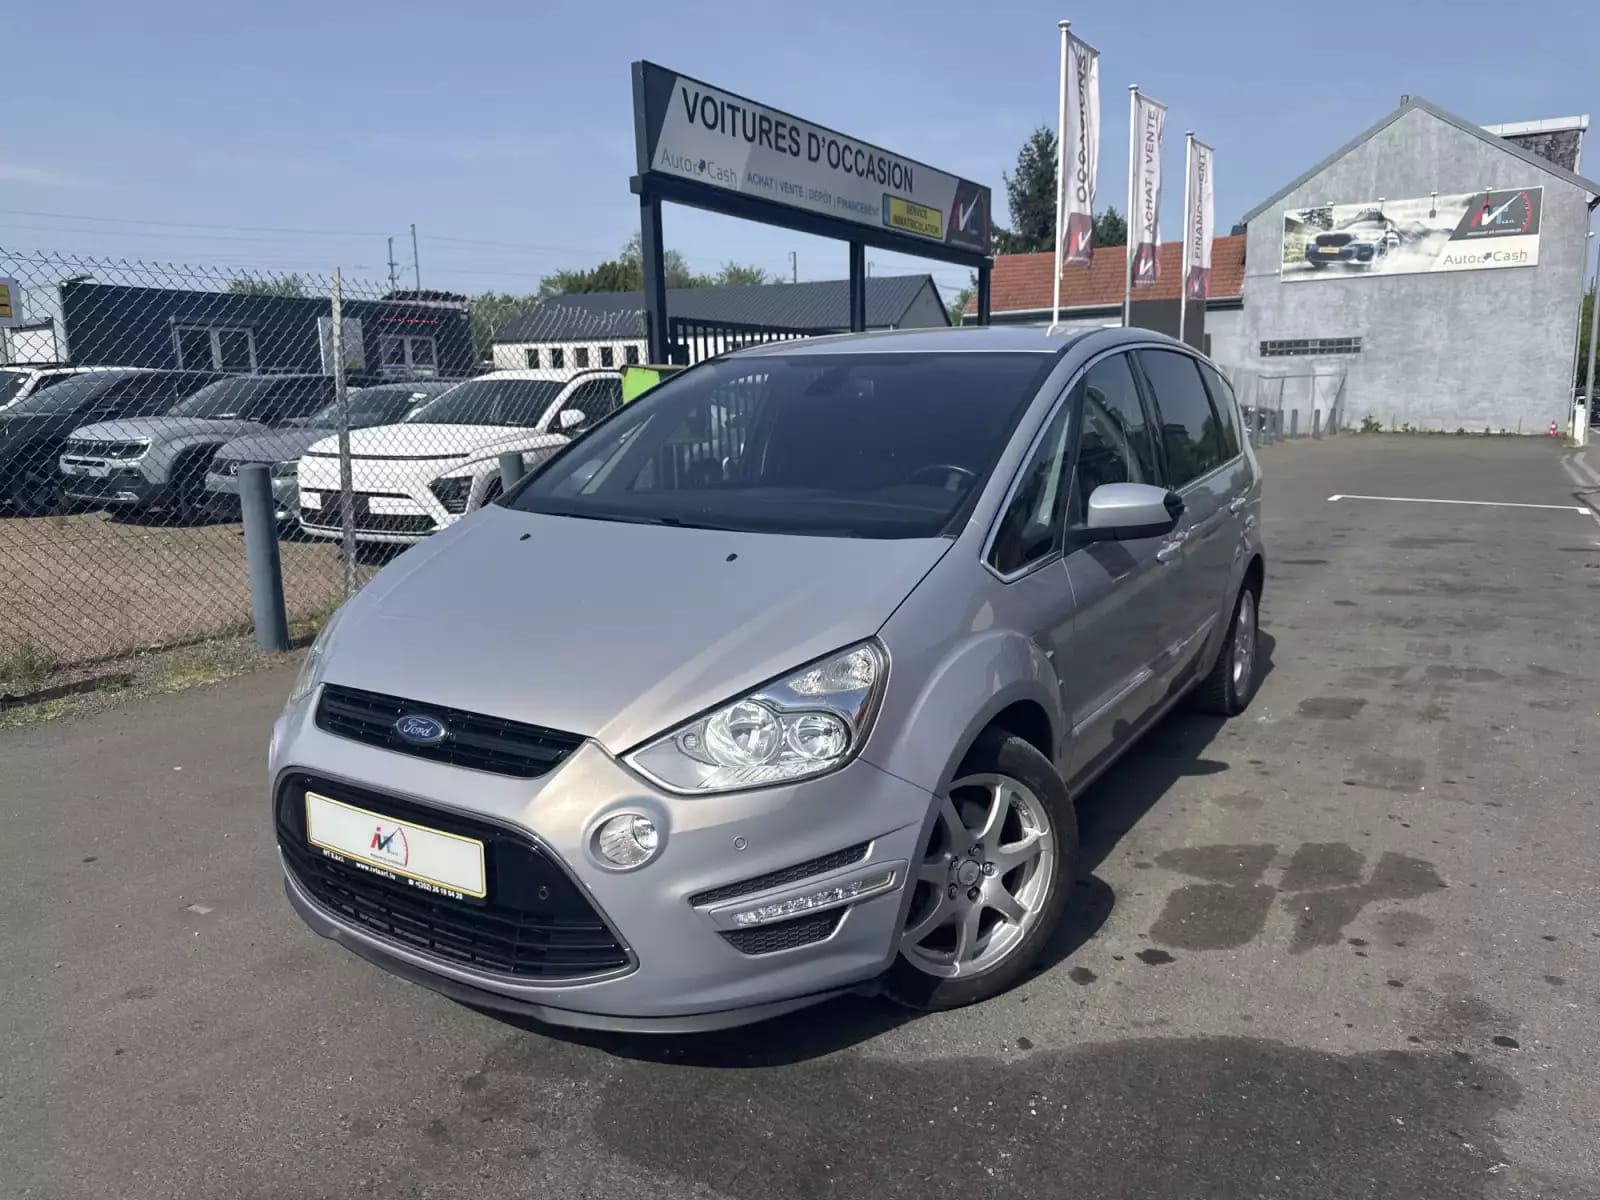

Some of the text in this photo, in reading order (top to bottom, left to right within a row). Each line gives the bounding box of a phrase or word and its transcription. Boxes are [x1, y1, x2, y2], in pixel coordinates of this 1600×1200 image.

[681, 87, 914, 194] VOITURES D'OCCASION
[707, 161, 738, 184] Cash
[1144, 109, 1156, 235] ACHAT VENTE
[746, 172, 774, 191] ACHAT
[780, 182, 804, 198] VENTE
[1493, 250, 1528, 263] Cash
[403, 718, 434, 737] Ford
